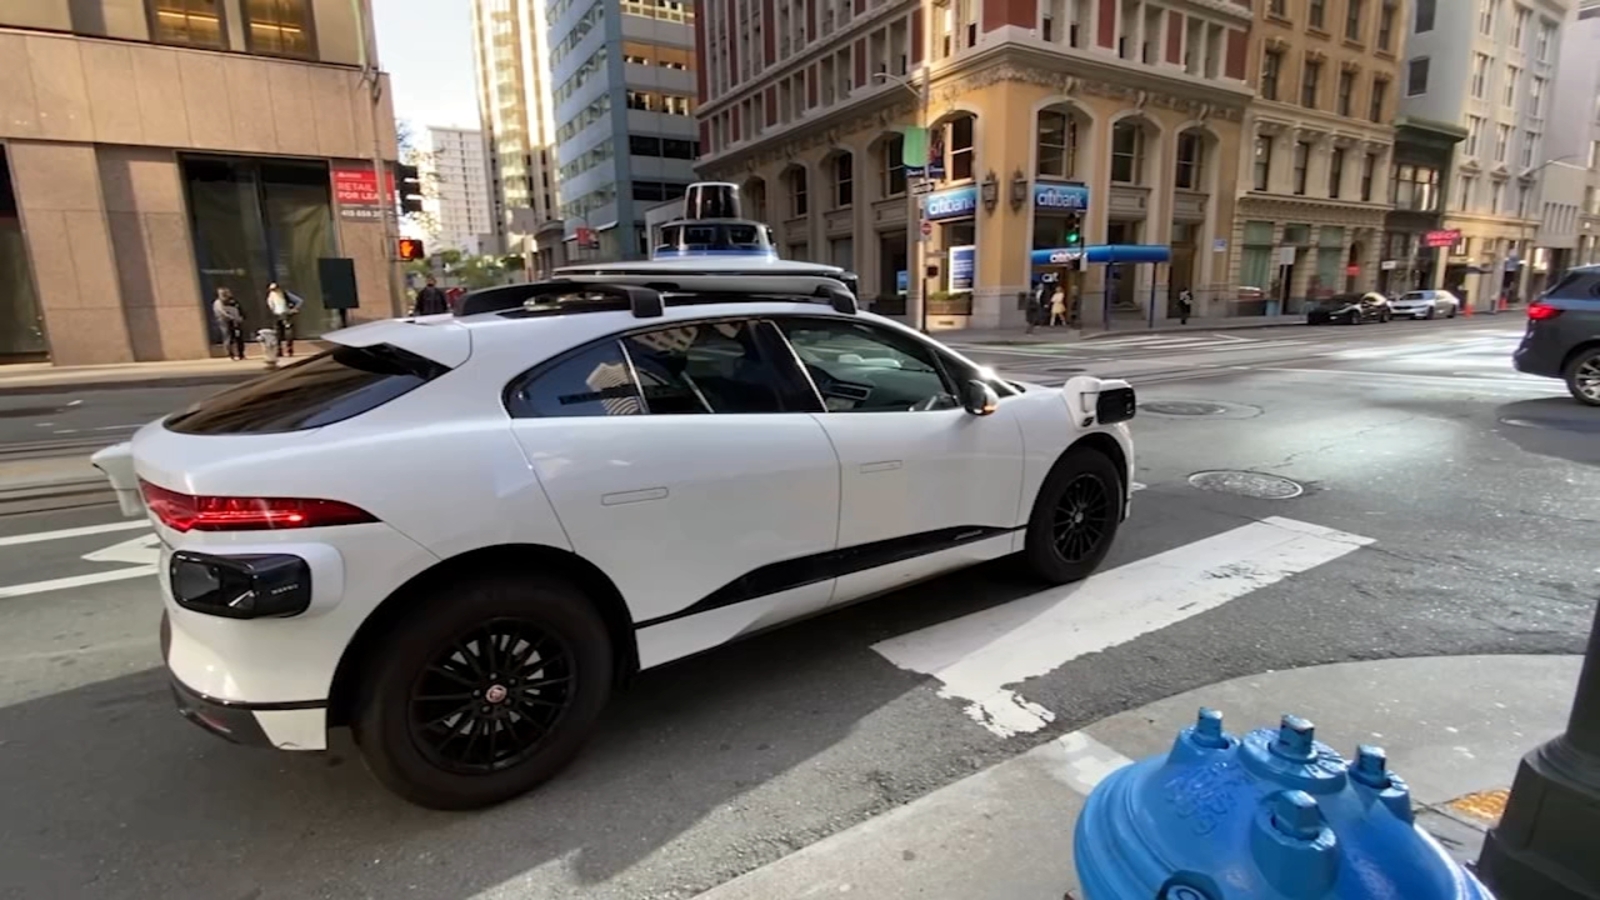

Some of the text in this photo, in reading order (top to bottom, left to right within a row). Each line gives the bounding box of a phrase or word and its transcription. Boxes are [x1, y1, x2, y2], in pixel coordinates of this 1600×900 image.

[337, 182, 375, 191] RETAIL
[337, 191, 392, 201] FOR LEAE
[1037, 187, 1083, 208] citibank
[928, 193, 974, 216] citibank
[1050, 251, 1088, 263] citib
